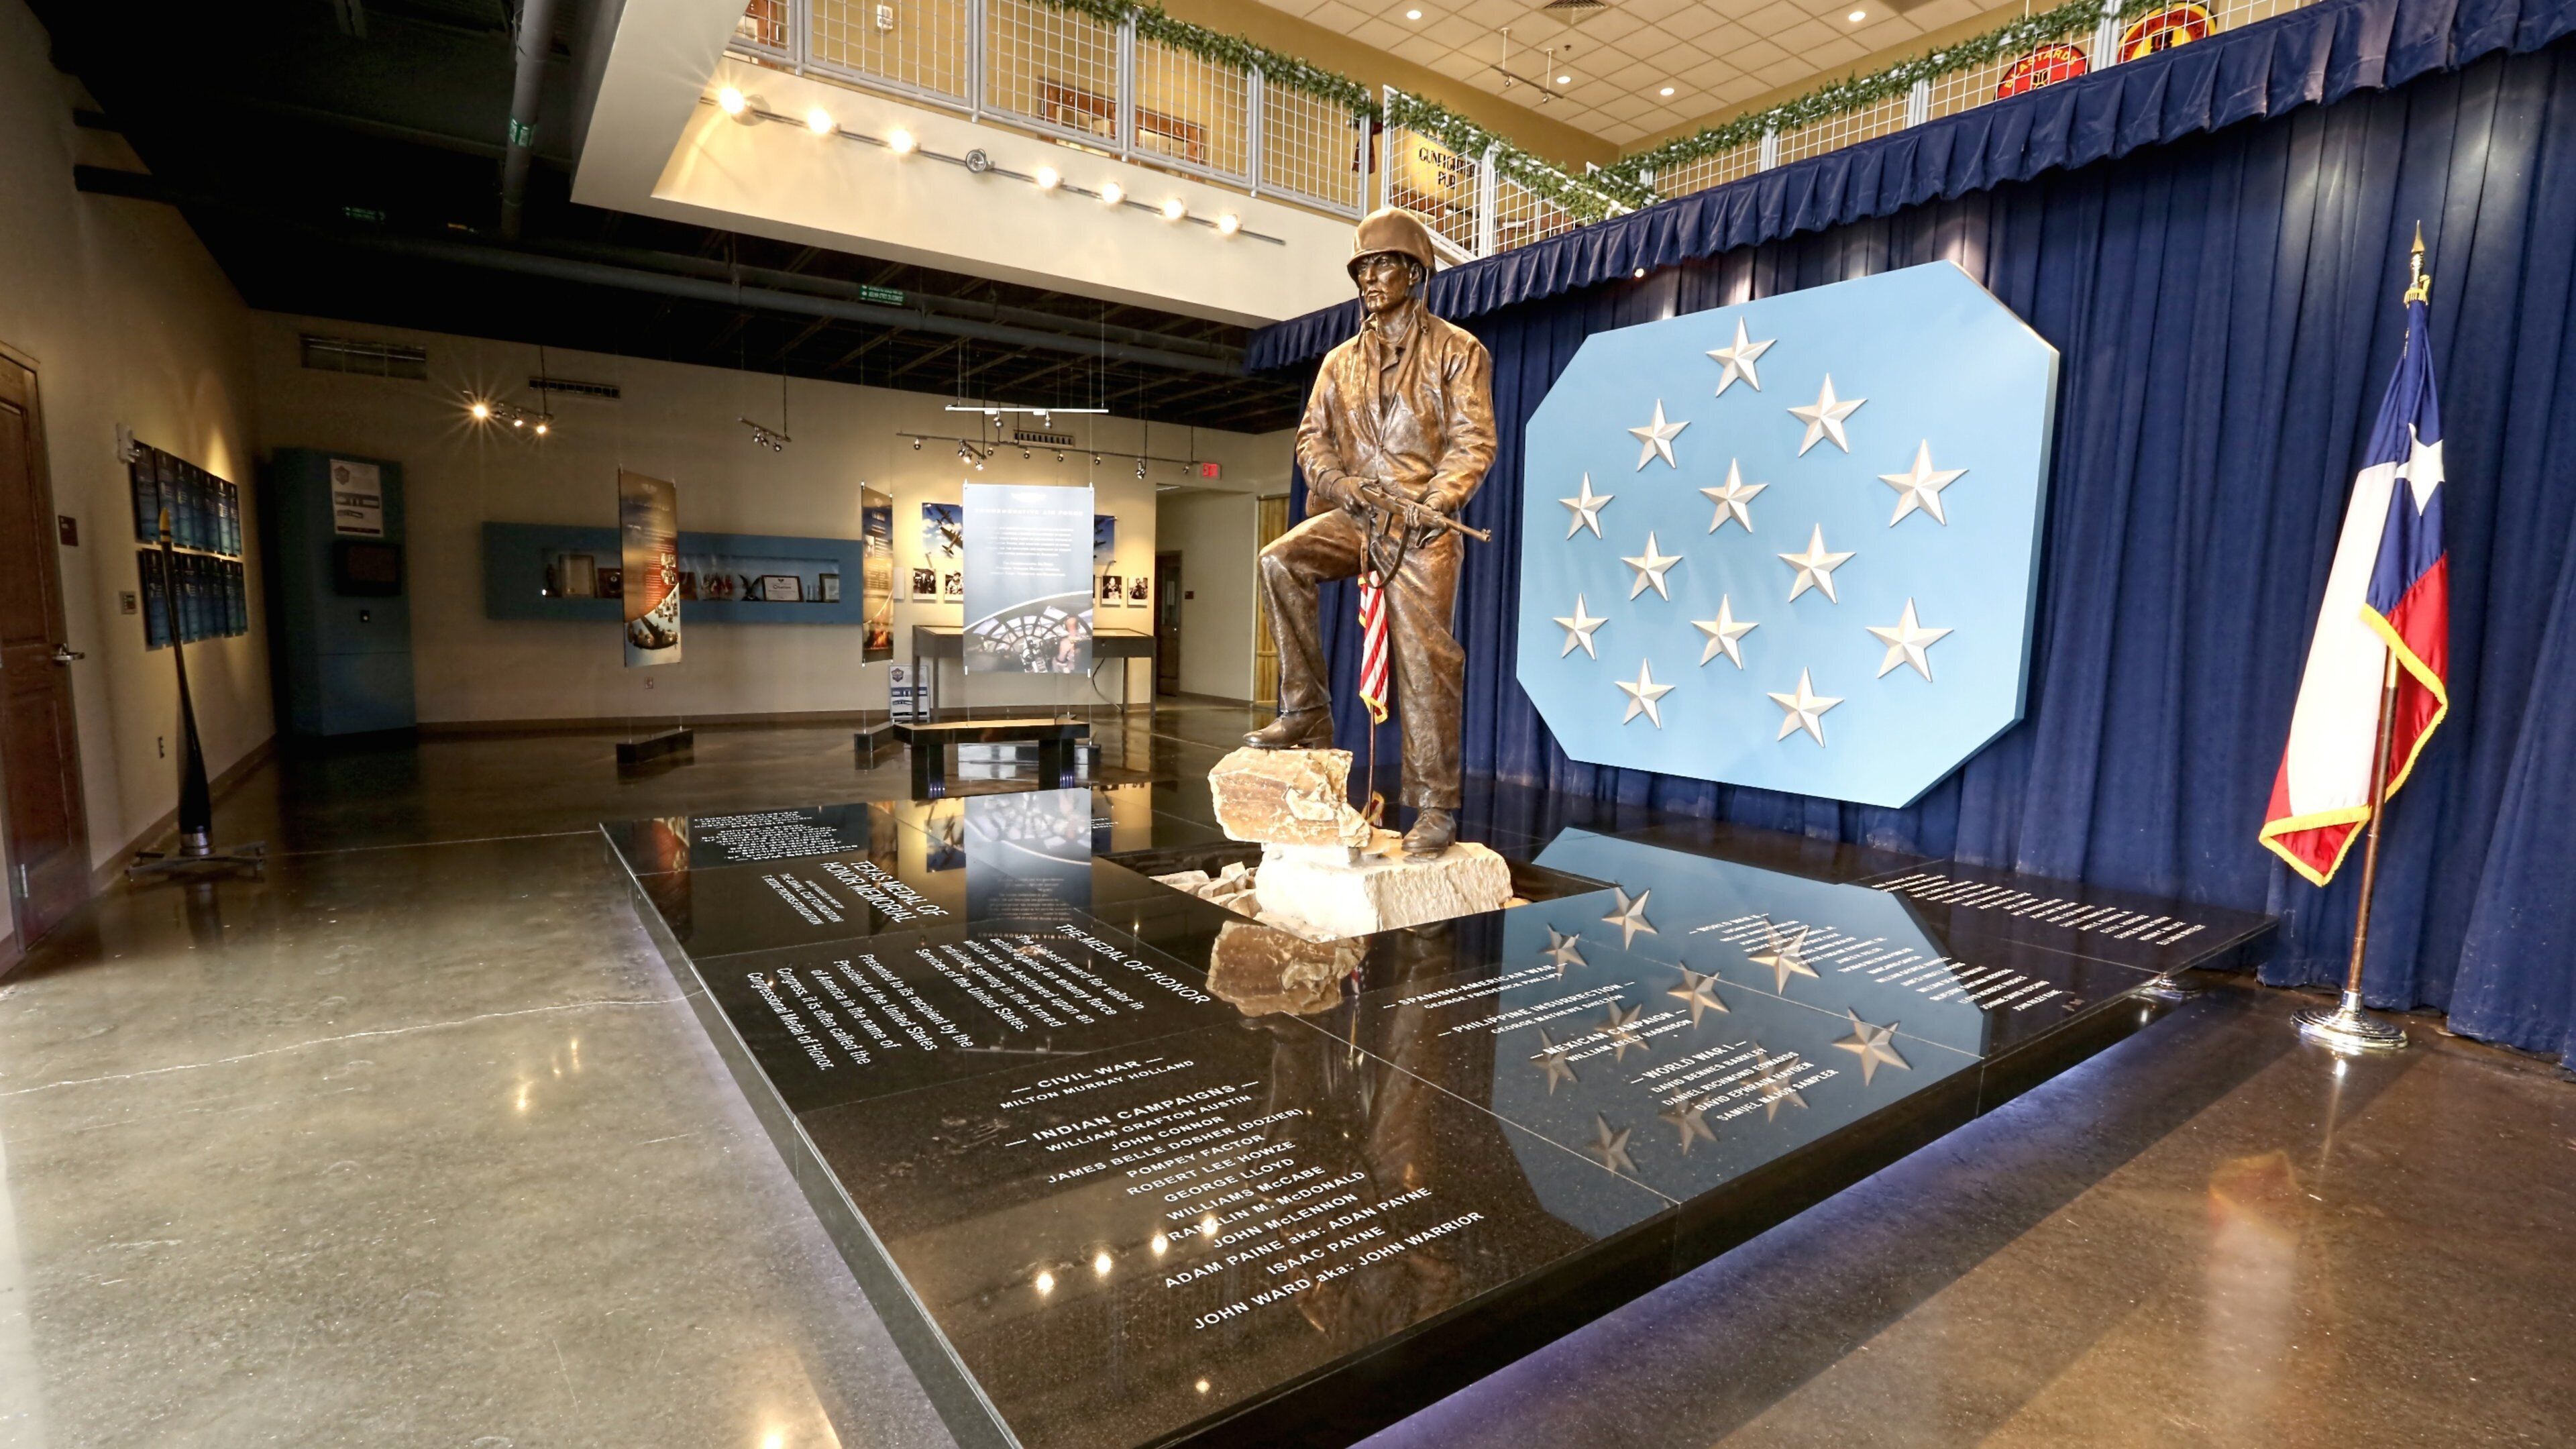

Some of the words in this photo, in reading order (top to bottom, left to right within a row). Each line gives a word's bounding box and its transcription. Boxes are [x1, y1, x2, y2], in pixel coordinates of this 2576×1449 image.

[820, 862, 865, 885] HONOR
[850, 884, 917, 923] MEMORIAL
[850, 860, 893, 881] TEXAS
[877, 881, 928, 906] MEDAL
[916, 905, 949, 916] OF
[777, 967, 808, 997] Congress,
[963, 940, 990, 954] which
[984, 954, 1003, 964] can
[998, 963, 1014, 971] be
[1010, 971, 1059, 998] bestowed
[1051, 998, 1080, 1014] upon
[1075, 1014, 1095, 1024] an
[987, 938, 1021, 953] action
[1013, 953, 1050, 972] against
[1056, 979, 1091, 998] enemy
[1086, 998, 1117, 1015] force
[1012, 934, 1038, 945] The
[1060, 962, 1095, 979] award
[1087, 978, 1108, 987] for
[1104, 987, 1134, 1002] valor
[1128, 1002, 1144, 1010] in
[1056, 924, 1088, 938] THE
[1078, 937, 1128, 961] MEDAL
[1124, 960, 1153, 971] OF
[1144, 972, 1211, 1004] HONOR
[1398, 972, 1527, 1005] SPANISH-AMERICAN
[1524, 965, 1556, 973] WAR
[747, 972, 793, 1014] Congressional
[806, 1002, 822, 1010] is
[816, 976, 847, 1000] America
[833, 960, 871, 987] President
[869, 994, 888, 1004] the
[881, 1004, 916, 1026] United
[906, 1026, 938, 1051] States
[840, 1000, 856, 1008] in
[859, 954, 900, 981] Presented
[898, 987, 914, 996] its
[907, 996, 951, 1024] recipient
[940, 1024, 959, 1034] by
[952, 1034, 973, 1047] the
[916, 949, 950, 971] Services
[953, 977, 971, 987] the
[967, 987, 1004, 1008] United
[994, 1008, 1028, 1032] States.
[971, 967, 1006, 988] serving
[1000, 986, 1014, 994] in
[1010, 994, 1029, 1004] the
[1023, 1004, 1067, 1027] Armed
[1424, 996, 1468, 1008] GEORGE
[1467, 983, 1523, 998] FREDERICK
[1519, 972, 1564, 984] PHILLIPS
[1452, 1008, 1532, 1032] PHILIPPINE
[1529, 984, 1623, 1011] INSURRECTION
[780, 1013, 810, 1035] Medal
[813, 1010, 837, 1028] often
[847, 1007, 866, 1019] the
[859, 1019, 887, 1039] name
[1491, 1019, 1536, 1033] GEORGE
[1534, 1006, 1582, 1022] MATHEWS
[1582, 994, 1625, 1008] SHELTON
[1543, 1032, 1609, 1055] MEXICAN
[1607, 1012, 1674, 1034] CAMPAIGN
[797, 1035, 819, 1044] of
[804, 1043, 834, 1070] Honor.
[829, 1028, 863, 1050] called
[850, 1050, 871, 1064] the
[880, 1040, 902, 1049] of
[1565, 1045, 1613, 1061] WILLIAM
[1610, 1034, 1643, 1047] KELLY
[1642, 1020, 1693, 1037] HARRISON
[1000, 1091, 1059, 1109] MILTON
[1063, 1077, 1123, 1094] MURRAY
[1128, 1061, 1194, 1079] HOLLAND
[1038, 1073, 1092, 1087] CIVIL
[1094, 1061, 1141, 1075] WAR
[1642, 1058, 1695, 1078] WORLD
[1692, 1047, 1728, 1061] WAR
[1650, 1079, 1685, 1093] DAVID
[1682, 1064, 1725, 1081] BENNES
[1722, 1048, 1767, 1066] BARKLEY
[1662, 1089, 1705, 1106] DANIEL
[1701, 1069, 1754, 1091] RICHMOND
[1752, 1052, 1799, 1071] EDWARDS
[1695, 1095, 1730, 1111] DAVID
[1727, 1077, 1777, 1097] EPHRAIM
[1772, 1062, 1814, 1079] HAYDEN
[1717, 1102, 1762, 1120] SAMUEL
[1758, 1087, 1796, 1104] MAJOR
[1792, 1069, 1839, 1089] SAMPLER
[1032, 1116, 1111, 1140] INDIAN
[1117, 1085, 1236, 1119] CAMPAIGNS
[1045, 1130, 1118, 1151] WILLIAM
[1122, 1110, 1196, 1132] GRAFTON
[1199, 1095, 1252, 1113] AUSTIN
[1112, 1134, 1154, 1150] JOHN
[1158, 1116, 1225, 1137] CONNOR
[1049, 1163, 1106, 1183] JAMES
[1110, 1146, 1166, 1165] BELLE
[1168, 1128, 1235, 1149] DOSHER
[1237, 1109, 1303, 1131] (DOZIER)
[1126, 1153, 1195, 1178] POMPEY
[1200, 1134, 1265, 1157] FACTOR
[1126, 1169, 1197, 1195] ROBERT
[1201, 1159, 1236, 1173] LEE
[1237, 1141, 1295, 1163] HOWZE
[1164, 1175, 1238, 1201] GEORGE
[1240, 1159, 1294, 1179] LLOYD
[1166, 1189, 1254, 1220] WILLIAMS
[1256, 1166, 1325, 1192] McCABE
[1157, 1209, 1251, 1245] RANLIN
[1251, 1203, 1275, 1213] M.
[1275, 1172, 1365, 1205] McDONALD
[1214, 1226, 1263, 1248] JOHN
[1264, 1193, 1358, 1230] McLENNON
[1165, 1262, 1223, 1288] ADAM
[1226, 1240, 1285, 1265] PAINE
[1289, 1227, 1326, 1244] aka:
[1329, 1208, 1377, 1230] ADAN
[1377, 1187, 1432, 1211] PAYNE
[1267, 1249, 1325, 1275] ISAAC
[1326, 1226, 1385, 1252] PAYNE
[1195, 1302, 1249, 1329] JOHN
[1250, 1279, 1311, 1305] WARD
[1316, 1264, 1354, 1282] aka:
[1358, 1242, 1405, 1265] JOHN
[1404, 1212, 1484, 1245] WARRIOR
